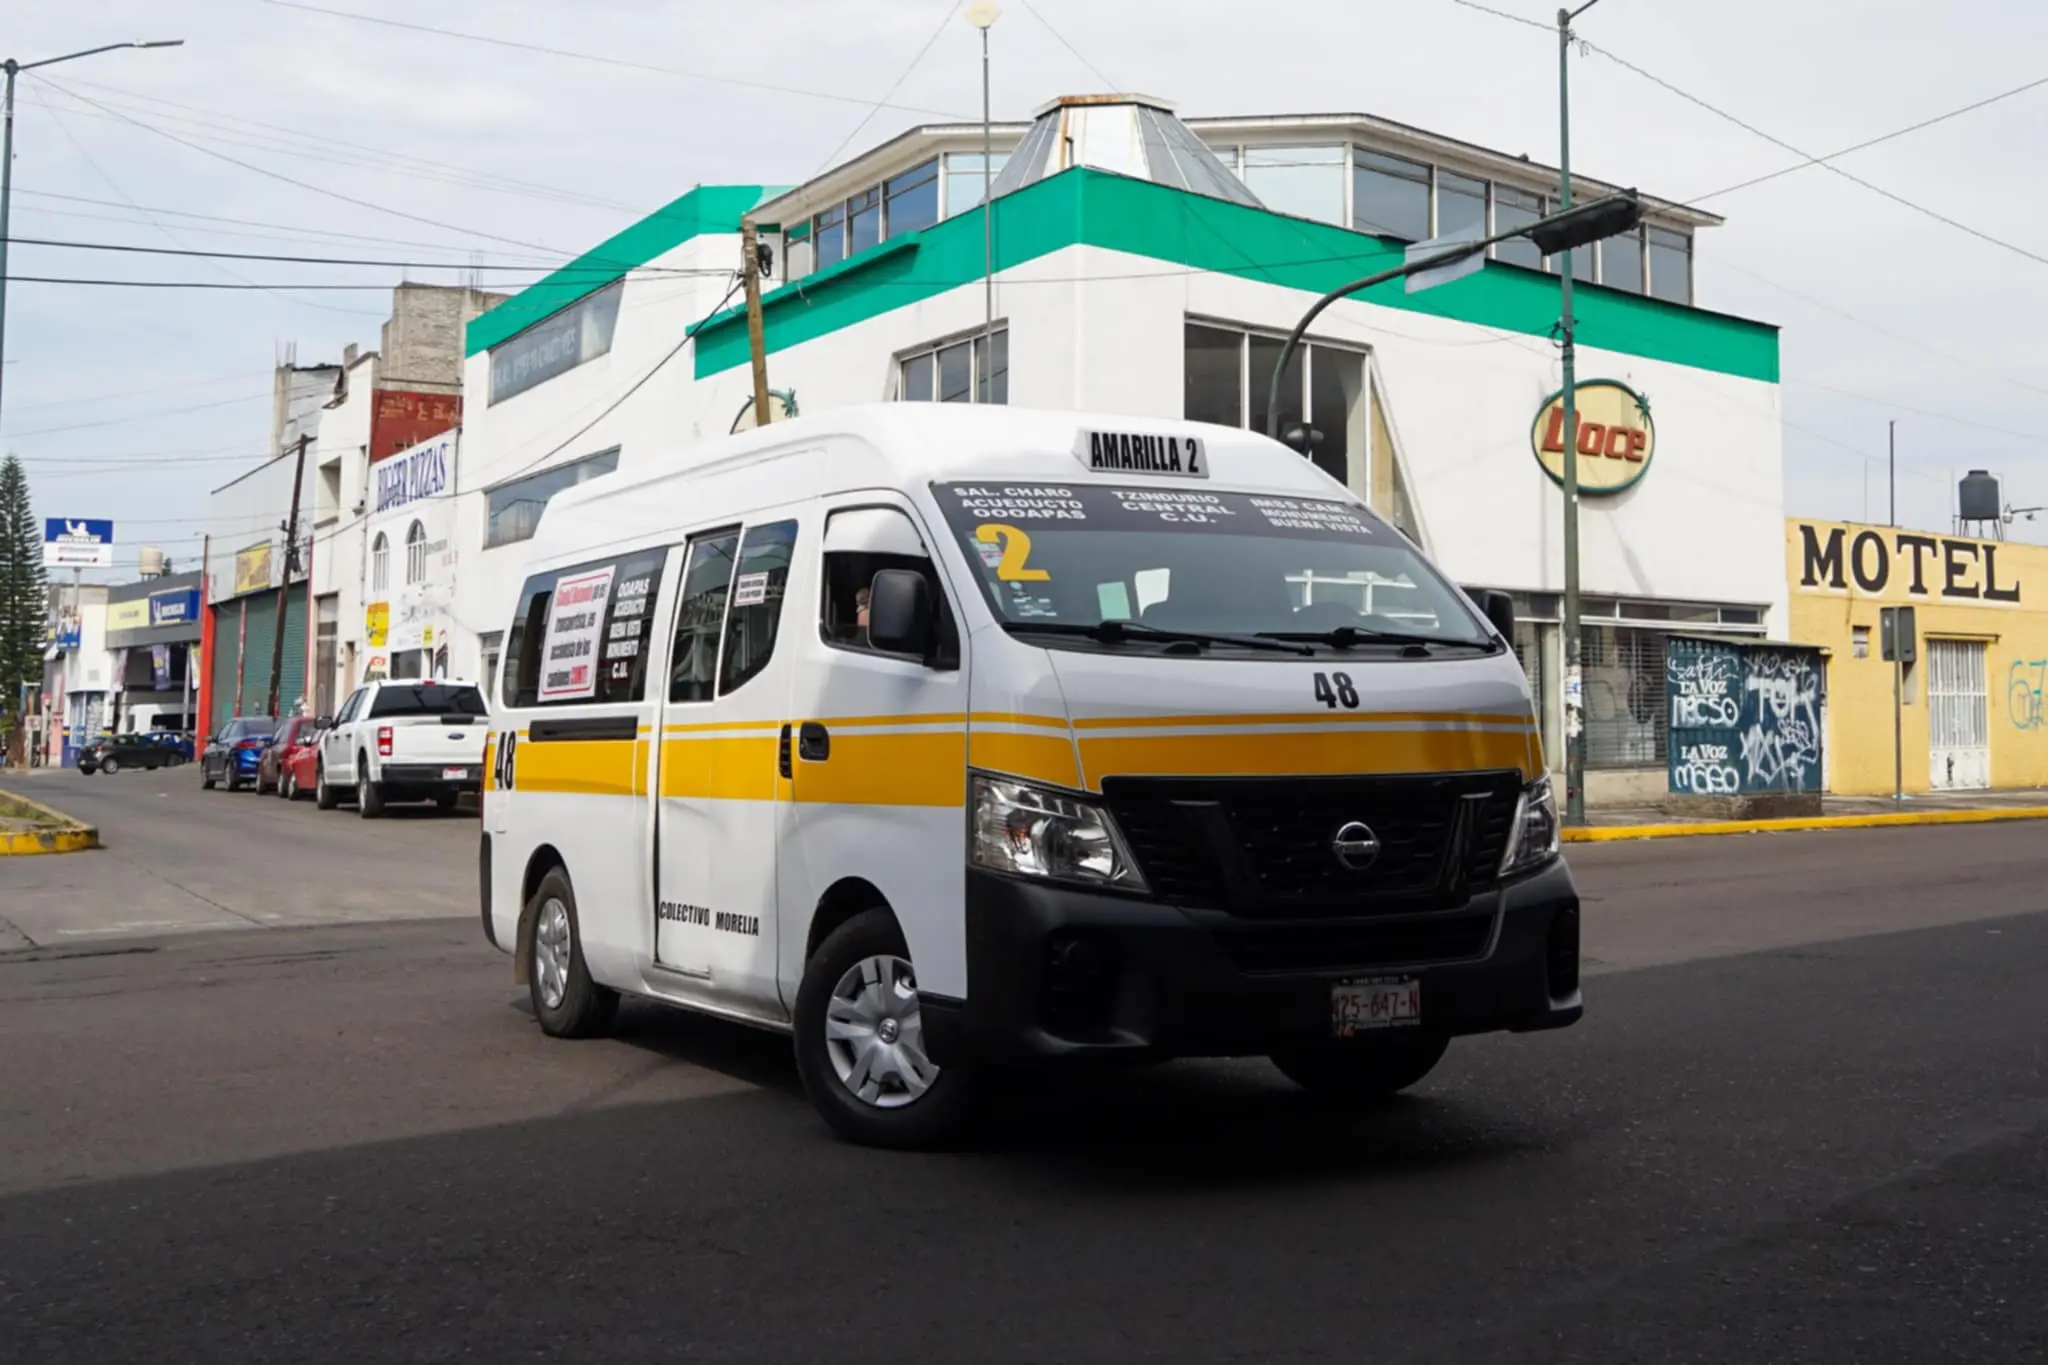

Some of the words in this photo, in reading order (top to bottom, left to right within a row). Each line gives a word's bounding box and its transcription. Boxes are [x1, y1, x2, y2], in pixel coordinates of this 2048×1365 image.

[1090, 432, 1181, 472] AMARILLA
[1186, 438, 1199, 473] 2
[409, 442, 448, 502] PIZZAS
[962, 499, 1083, 509] ACUEDUCTO
[1003, 487, 1073, 498] CHARO
[1122, 501, 1237, 515] CENTRAL
[1160, 512, 1217, 523] C.U.
[975, 523, 1051, 581] 2
[1799, 524, 2021, 602] MOTEL
[1313, 672, 1360, 709] 48
[495, 731, 516, 790] 48
[1699, 744, 1728, 760] VOZ
[660, 901, 710, 927] COLECTIVO
[715, 911, 759, 936] MORELIA
